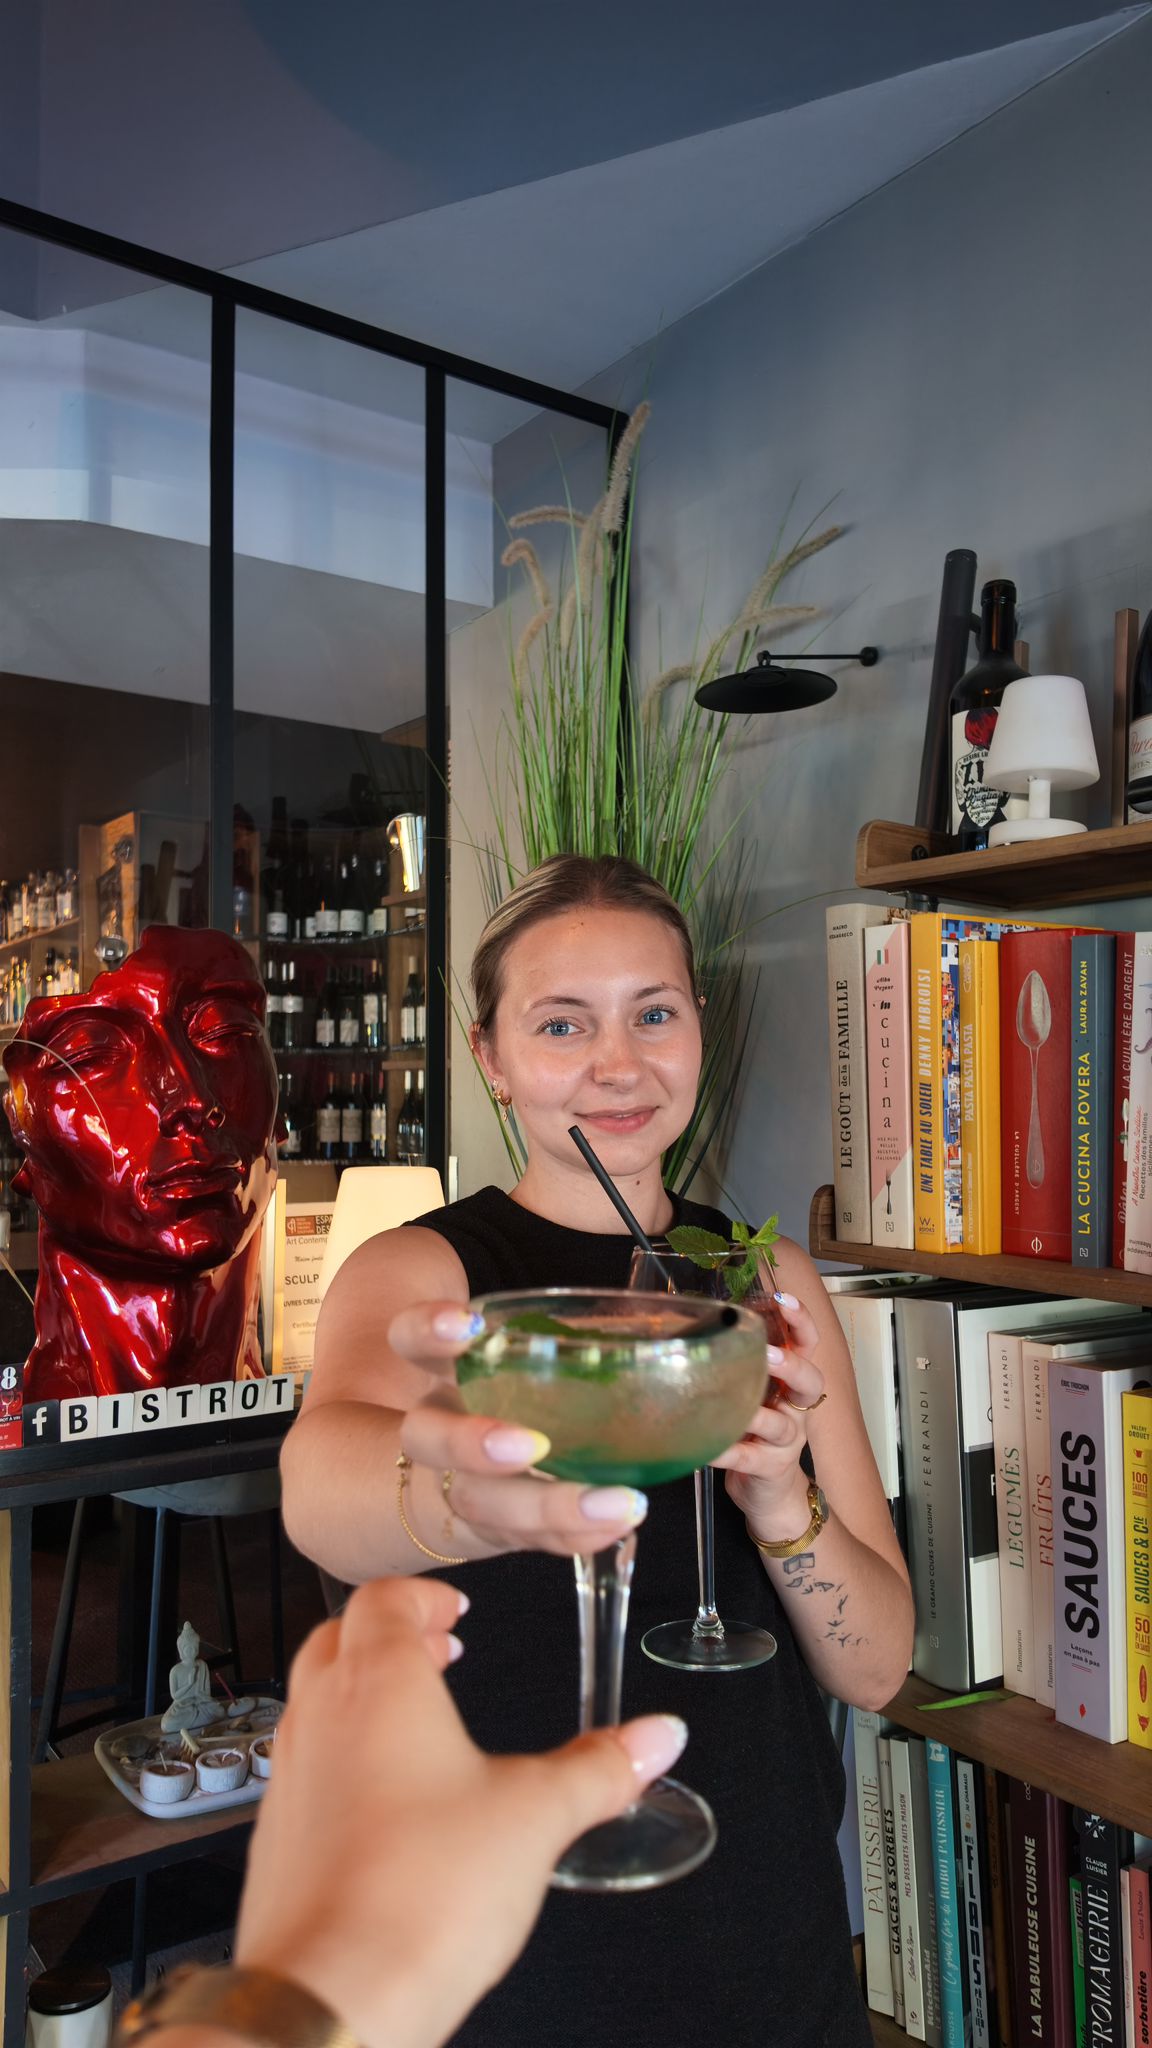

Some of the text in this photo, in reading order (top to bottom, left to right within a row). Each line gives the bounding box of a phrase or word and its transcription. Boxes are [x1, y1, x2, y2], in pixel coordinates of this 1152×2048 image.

[1123, 952, 1133, 1010] D'ARGENT
[1121, 1013, 1132, 1071] CUILLÈRE
[836, 980, 852, 1168] LE GOÛT de la FAMILLE
[918, 969, 934, 1194] UNE TABLE AU SOLEIL DENNY IMBROISI
[964, 1024, 974, 1122] PASTA PASTA PASTA
[1014, 1131, 1020, 1140] LA
[1078, 1052, 1090, 1235] LA CUCINA POVERA
[1140, 1112, 1148, 1144] familles
[284, 1274, 320, 1286] SCULP
[68, 1378, 288, 1435] BISTROT
[1002, 1350, 1010, 1410] FERRANDI
[1034, 1359, 1042, 1420] FERRANDI
[920, 1391, 932, 1487] FERRANDI
[1128, 1430, 1150, 1440] DROUET
[1132, 1472, 1148, 1484] 100
[1000, 1447, 1024, 1569] LÉGUMES
[1032, 1474, 1054, 1567] FRUITS
[1060, 1430, 1100, 1640] SAUCES
[928, 1537, 934, 1547] DE
[1135, 1536, 1149, 1548] &
[1134, 1551, 1150, 1604] SAUCES
[1070, 1643, 1093, 1656] Leçons
[1134, 1616, 1150, 1634] 50
[1072, 1652, 1084, 1662] pas
[1089, 1658, 1100, 1668] pas
[898, 1793, 906, 1820] MAISON
[900, 1824, 908, 1844] FAITS
[936, 1789, 948, 1855] PÂTISSIER
[862, 1775, 884, 1914] PÂTISSERIE
[902, 1845, 911, 1882] DESSERTS
[1086, 1856, 1108, 1868] CLAUDE
[1086, 1864, 1108, 1876] LUISIER
[884, 1808, 900, 1955] GLACES & SORBETS
[938, 1858, 950, 1899] ROBOT
[1024, 1836, 1042, 2038] LA FABULEUSE CUISINE
[1074, 1891, 1084, 1930] FACILE
[924, 1949, 934, 2026] KitchenAid
[1138, 1971, 1149, 2044] sorbetière
